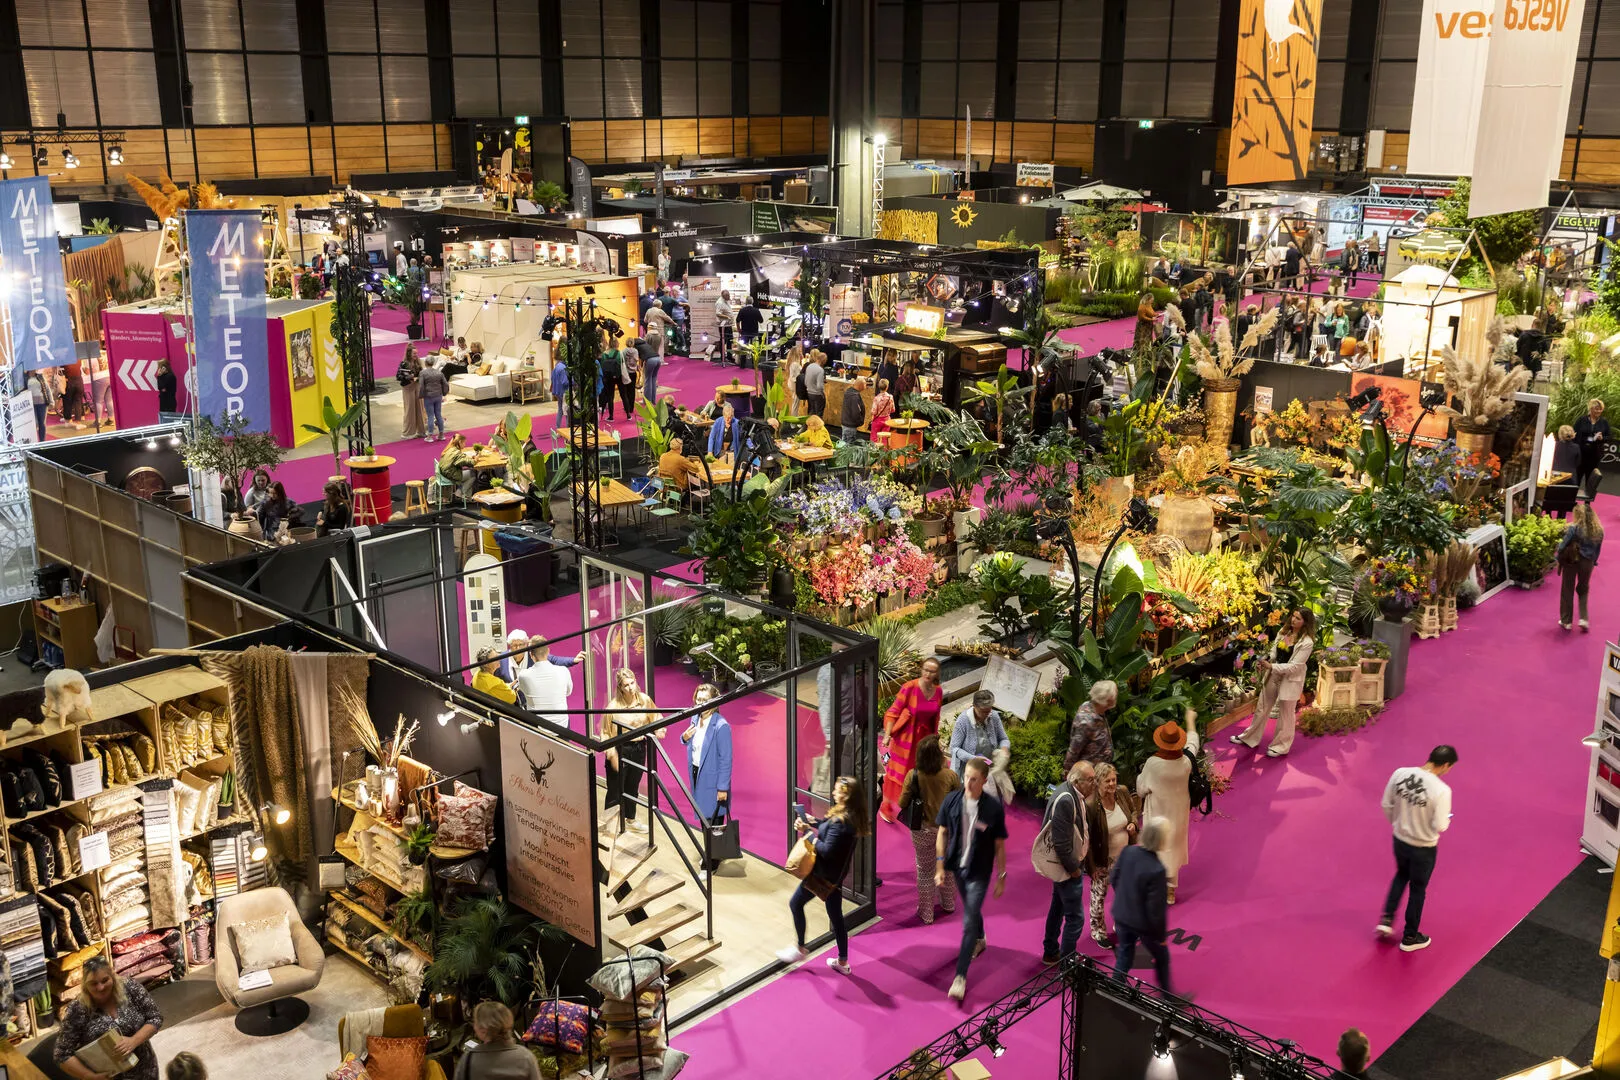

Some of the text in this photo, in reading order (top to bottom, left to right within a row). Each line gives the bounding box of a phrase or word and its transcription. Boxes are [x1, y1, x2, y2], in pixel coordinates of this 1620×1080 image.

[678, 228, 697, 236] Nederland
[11, 187, 54, 362] METEOR
[210, 222, 249, 426] METEOR
[515, 804, 569, 838] samenwerking
[570, 830, 586, 846] met
[516, 813, 576, 851] Tendenz wonen
[519, 846, 576, 882] Interieuradvies
[551, 888, 580, 908] wonen
